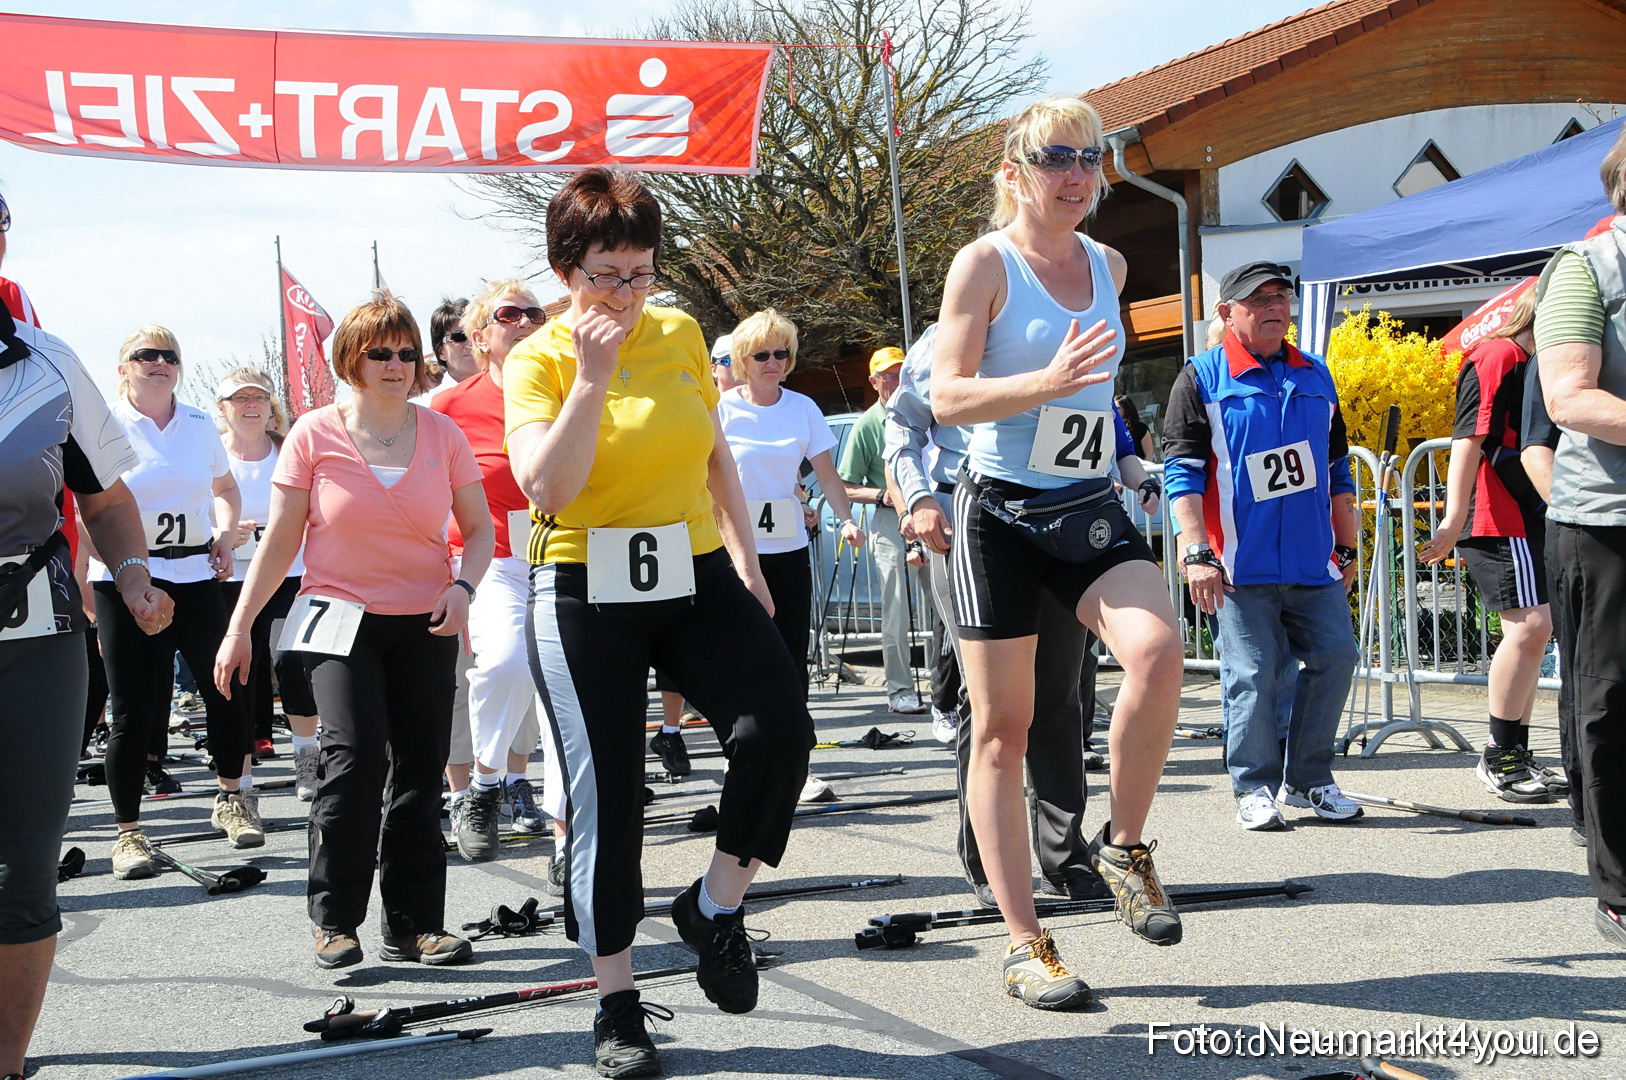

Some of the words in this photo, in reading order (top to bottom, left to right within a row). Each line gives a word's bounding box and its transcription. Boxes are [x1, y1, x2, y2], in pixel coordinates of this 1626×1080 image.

[1054, 413, 1105, 470] 24
[1263, 448, 1305, 493] 29
[155, 512, 187, 545] 21
[757, 502, 775, 533] 4
[628, 531, 659, 593] 6
[301, 598, 331, 645] 7
